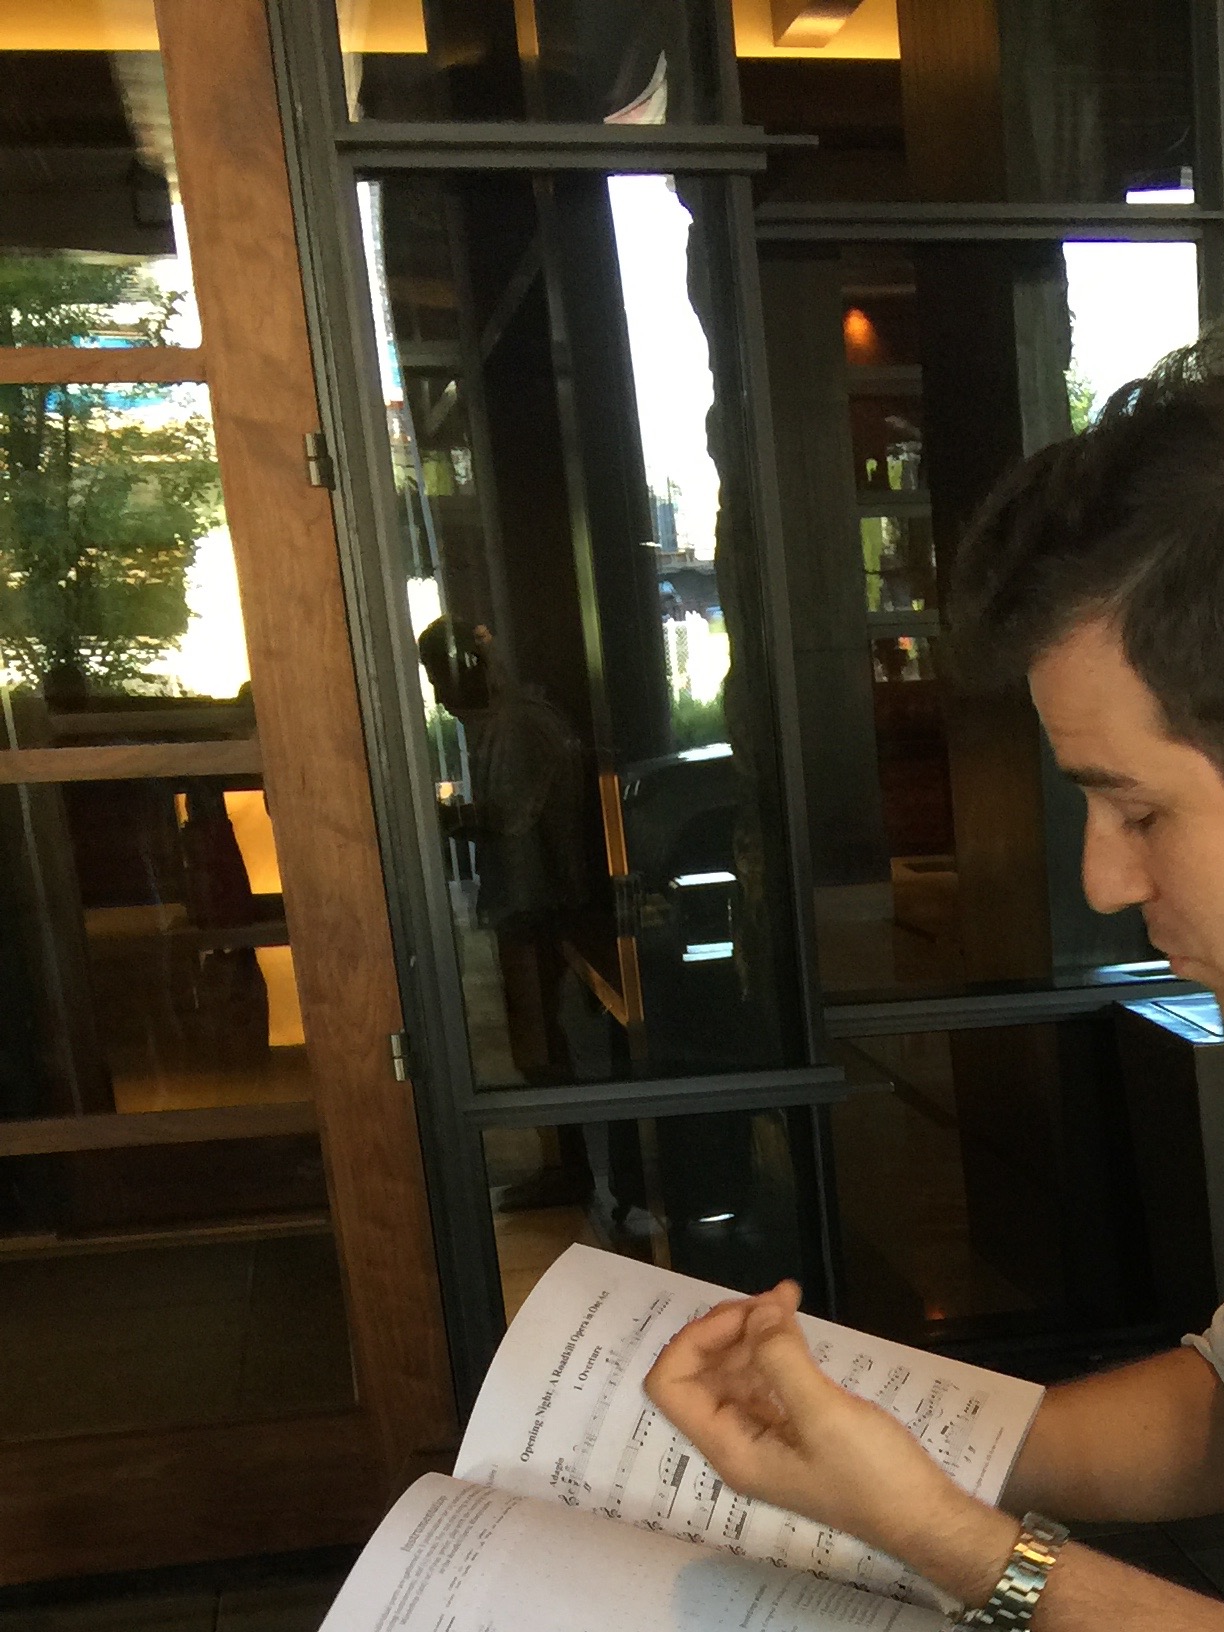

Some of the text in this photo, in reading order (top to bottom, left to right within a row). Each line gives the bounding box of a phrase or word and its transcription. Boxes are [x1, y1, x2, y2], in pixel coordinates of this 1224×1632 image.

[570, 1320, 589, 1344] Opera
[552, 1342, 575, 1378] Roadkill
[578, 1344, 603, 1382] Overture
[549, 1378, 559, 1387] A
[520, 1419, 544, 1463] Opening
[550, 1457, 565, 1488] Adagio
